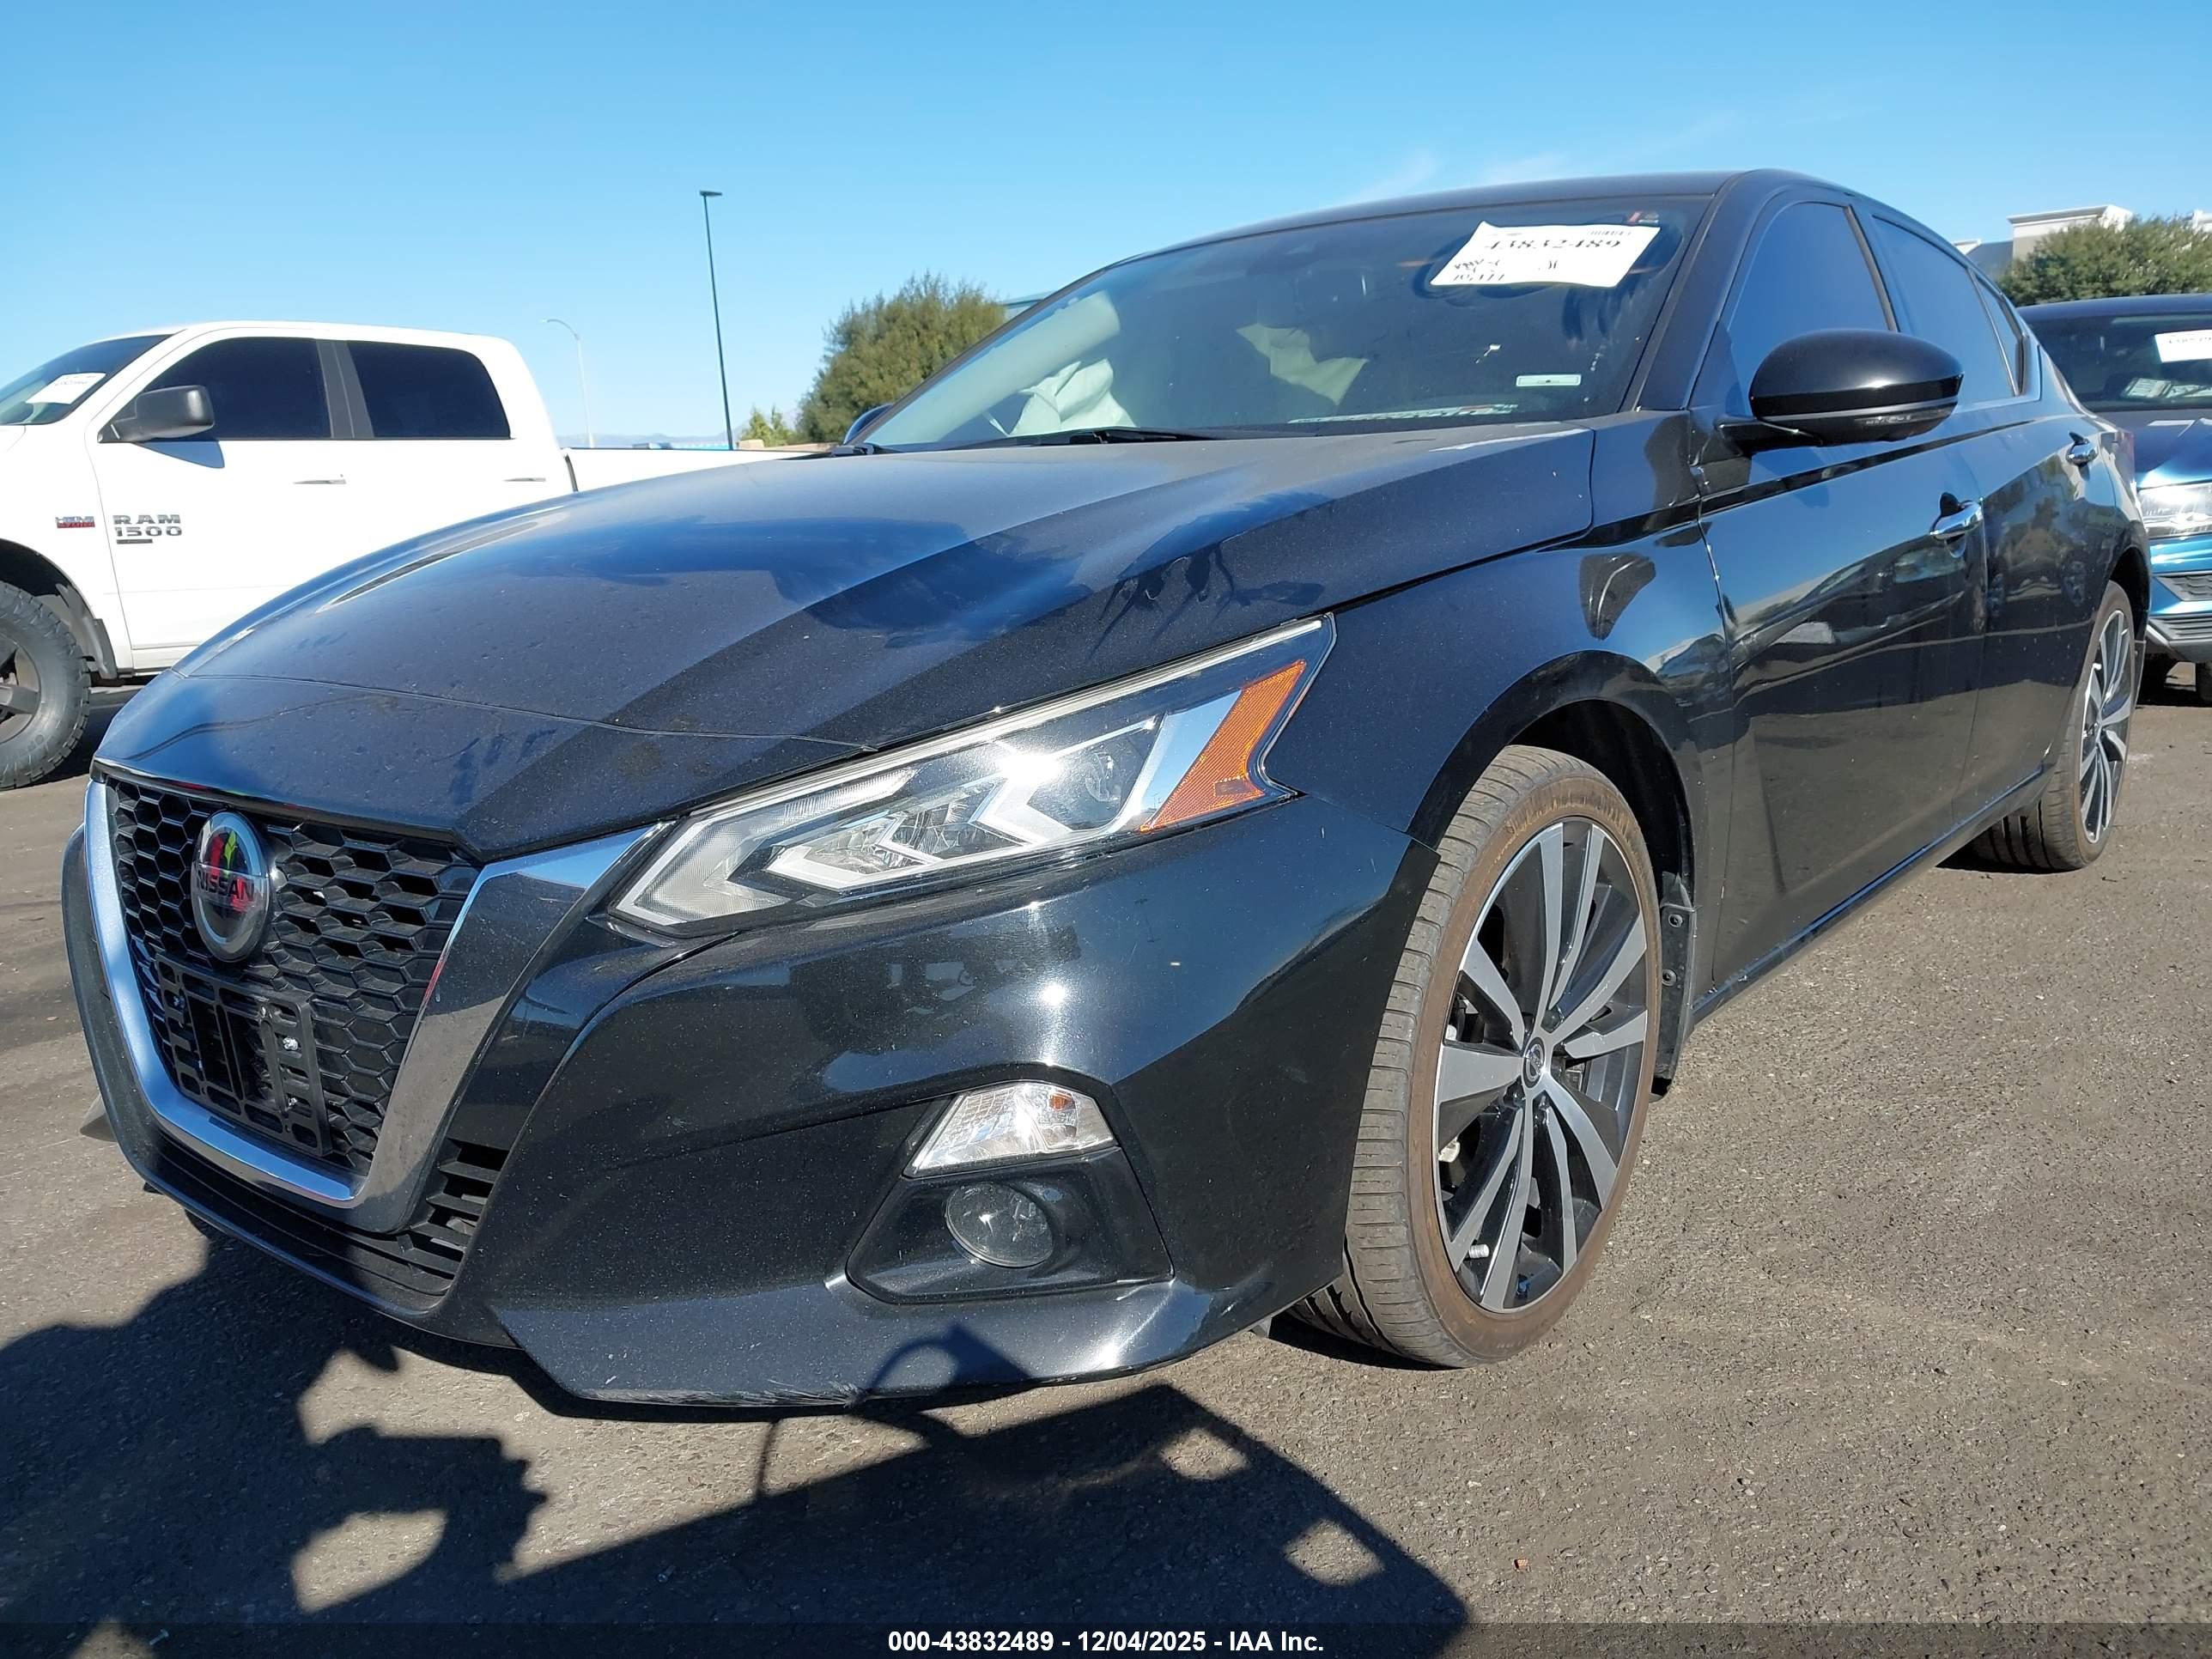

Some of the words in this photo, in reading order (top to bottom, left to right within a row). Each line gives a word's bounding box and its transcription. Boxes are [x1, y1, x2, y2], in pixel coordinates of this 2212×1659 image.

[112, 514, 181, 525] RAM
[114, 526, 182, 537] 1500
[196, 868, 255, 902] NISSAN
